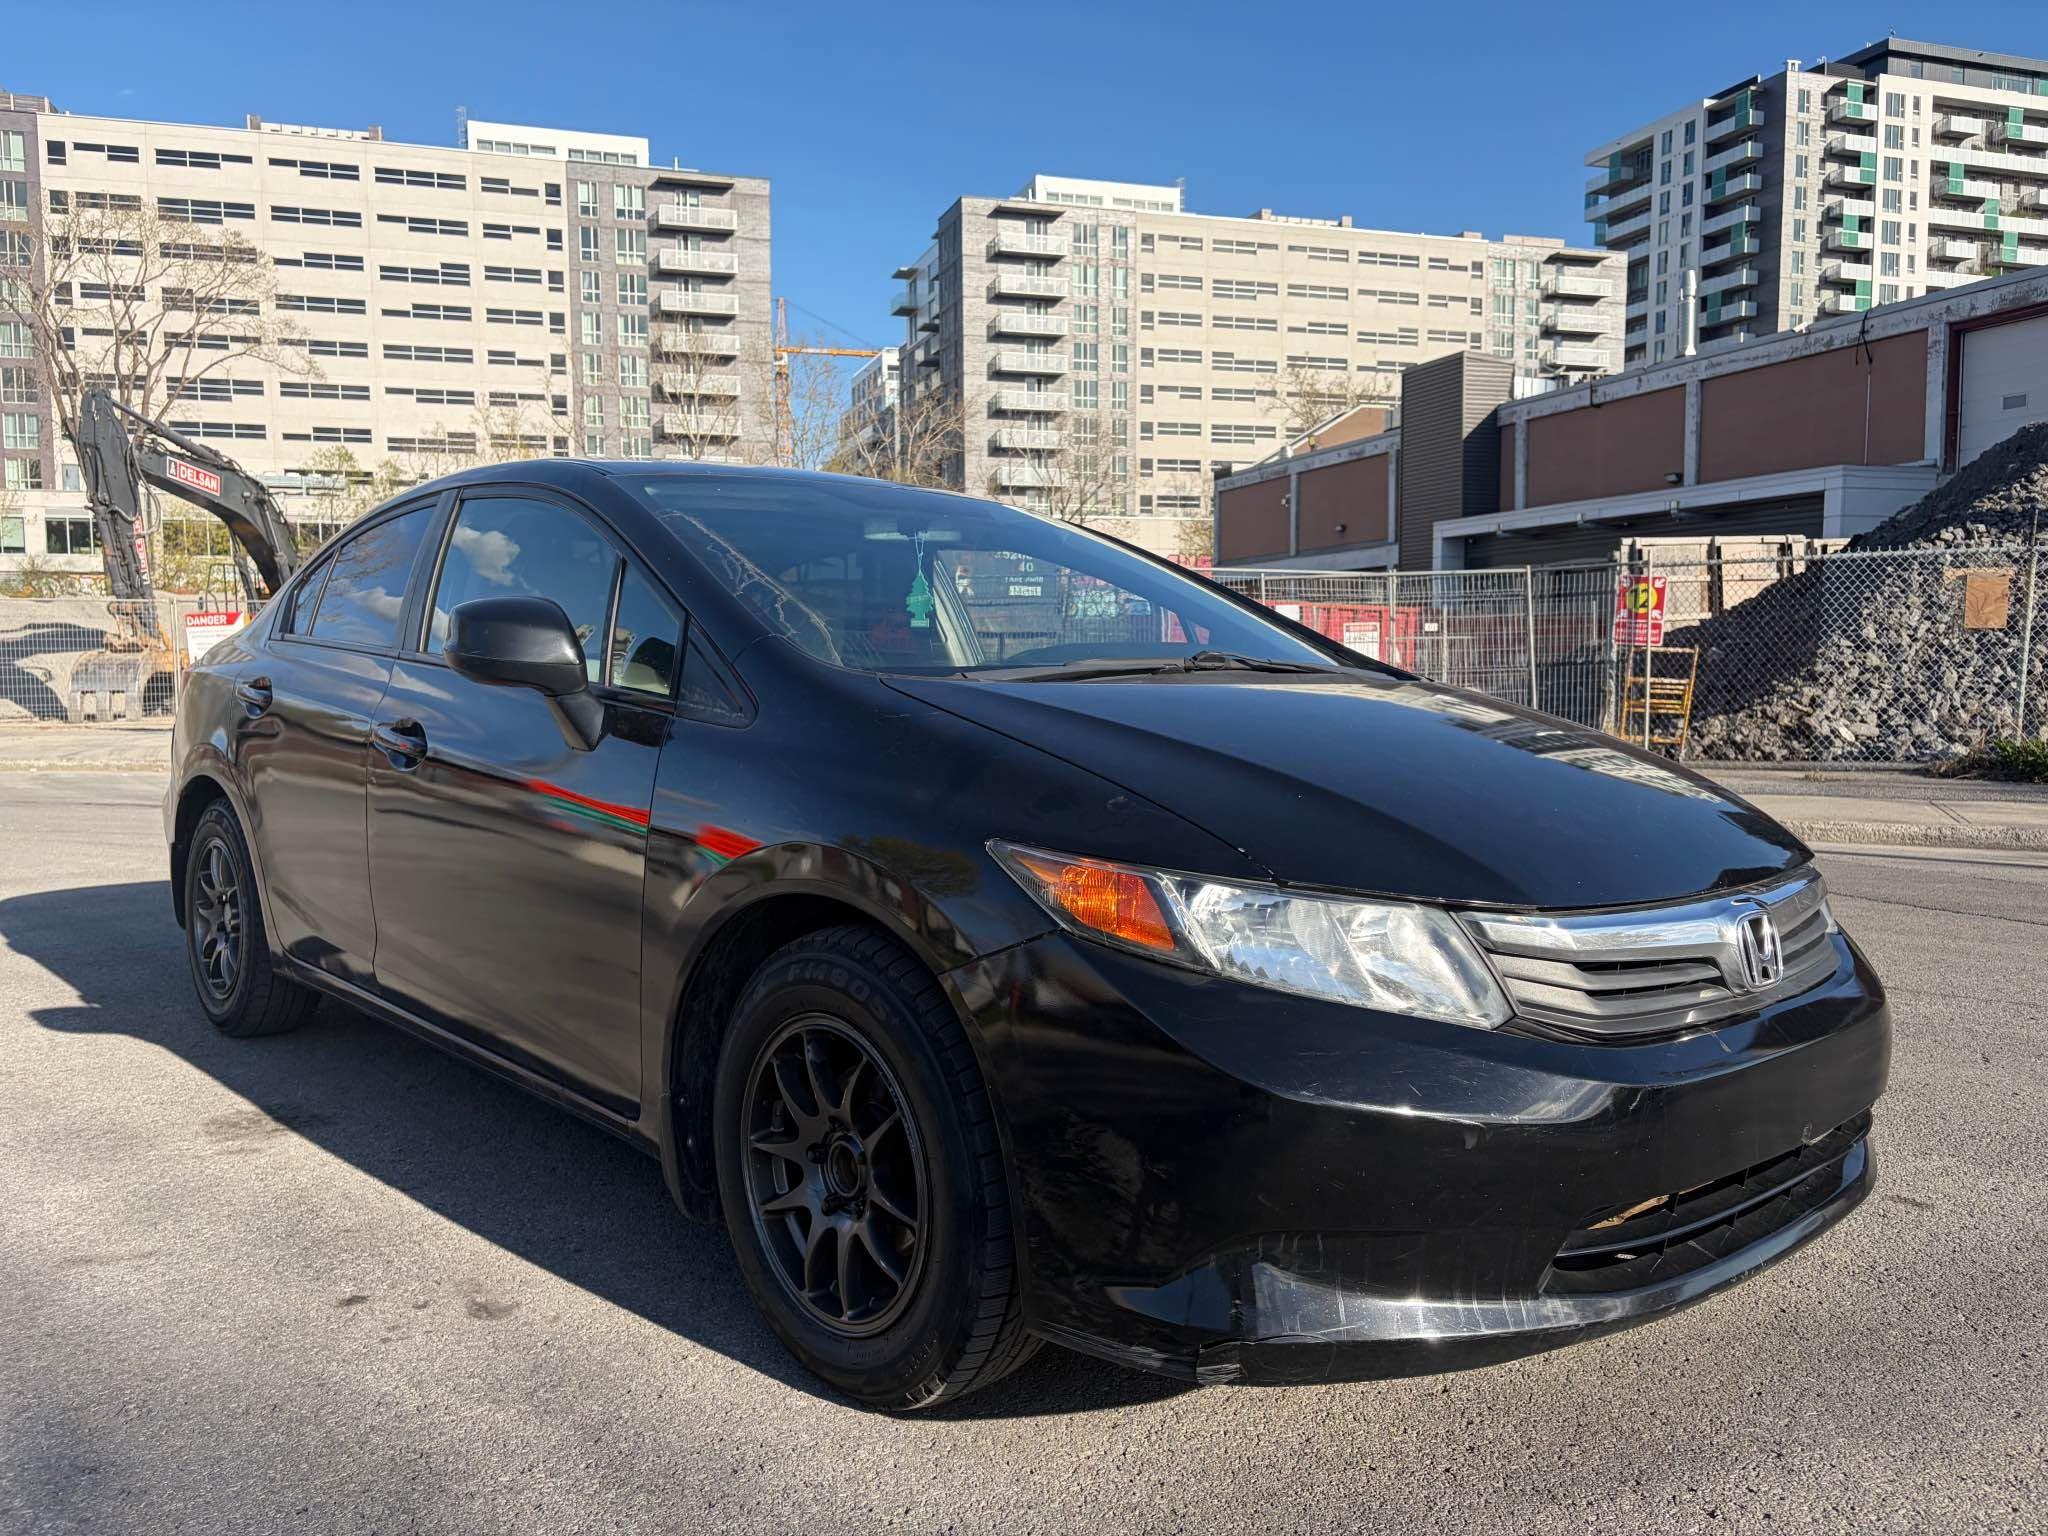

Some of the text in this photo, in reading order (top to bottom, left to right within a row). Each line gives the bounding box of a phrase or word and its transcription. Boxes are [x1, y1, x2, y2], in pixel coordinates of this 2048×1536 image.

[180, 466, 217, 492] DELSAN
[1630, 587, 1650, 610] 12
[186, 615, 227, 626] DANGER
